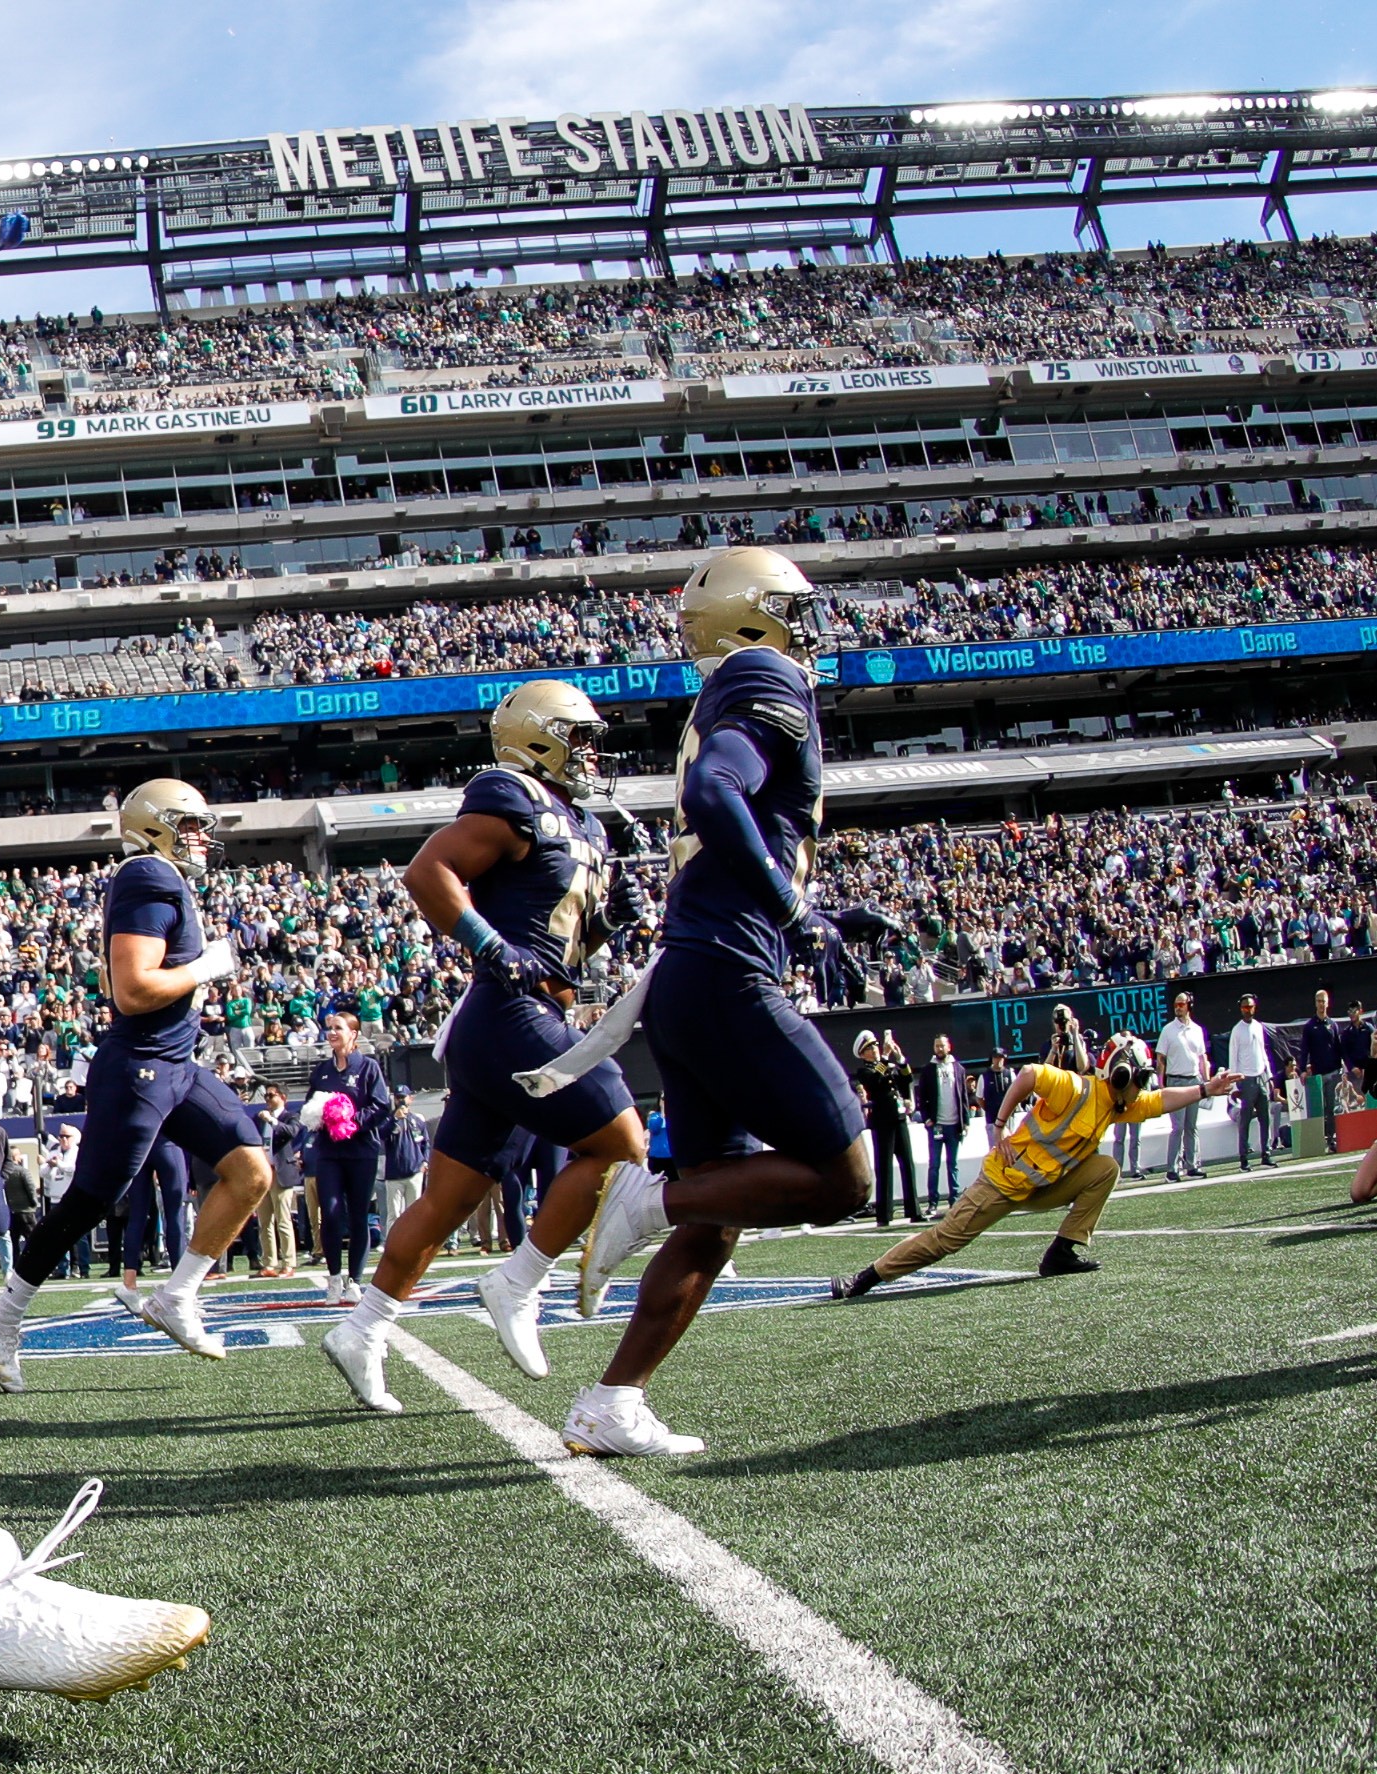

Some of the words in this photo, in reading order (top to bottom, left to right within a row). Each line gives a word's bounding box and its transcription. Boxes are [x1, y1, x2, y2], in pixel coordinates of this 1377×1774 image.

[268, 116, 544, 193] METLIFE
[554, 102, 823, 174] STADIUM
[1041, 362, 1071, 381] 75
[1094, 360, 1169, 377] WINSTON
[1169, 358, 1203, 374] HILL
[1306, 352, 1332, 370] 73
[783, 377, 831, 393] JETS
[840, 372, 887, 390] LEON
[889, 370, 933, 386] HESS
[400, 394, 438, 414] 60
[447, 391, 513, 410] LARRY
[518, 384, 632, 406] GRANTHAM
[36, 419, 77, 439] 99
[86, 415, 150, 434] MARK
[155, 407, 272, 430] GASTINEAU
[1239, 629, 1298, 654] Dame
[925, 646, 1035, 674] Welcome
[1068, 639, 1108, 665] the
[476, 668, 620, 710] preted
[626, 666, 661, 695] by
[295, 689, 380, 716] Dame
[52, 703, 101, 731] the
[821, 768, 875, 785] LIFE
[875, 761, 990, 780] STADIUM
[998, 1001, 1028, 1026] TO
[1098, 986, 1168, 1016] NOTRE
[1109, 1009, 1169, 1036] DAME
[1011, 1029, 1024, 1053] 3
